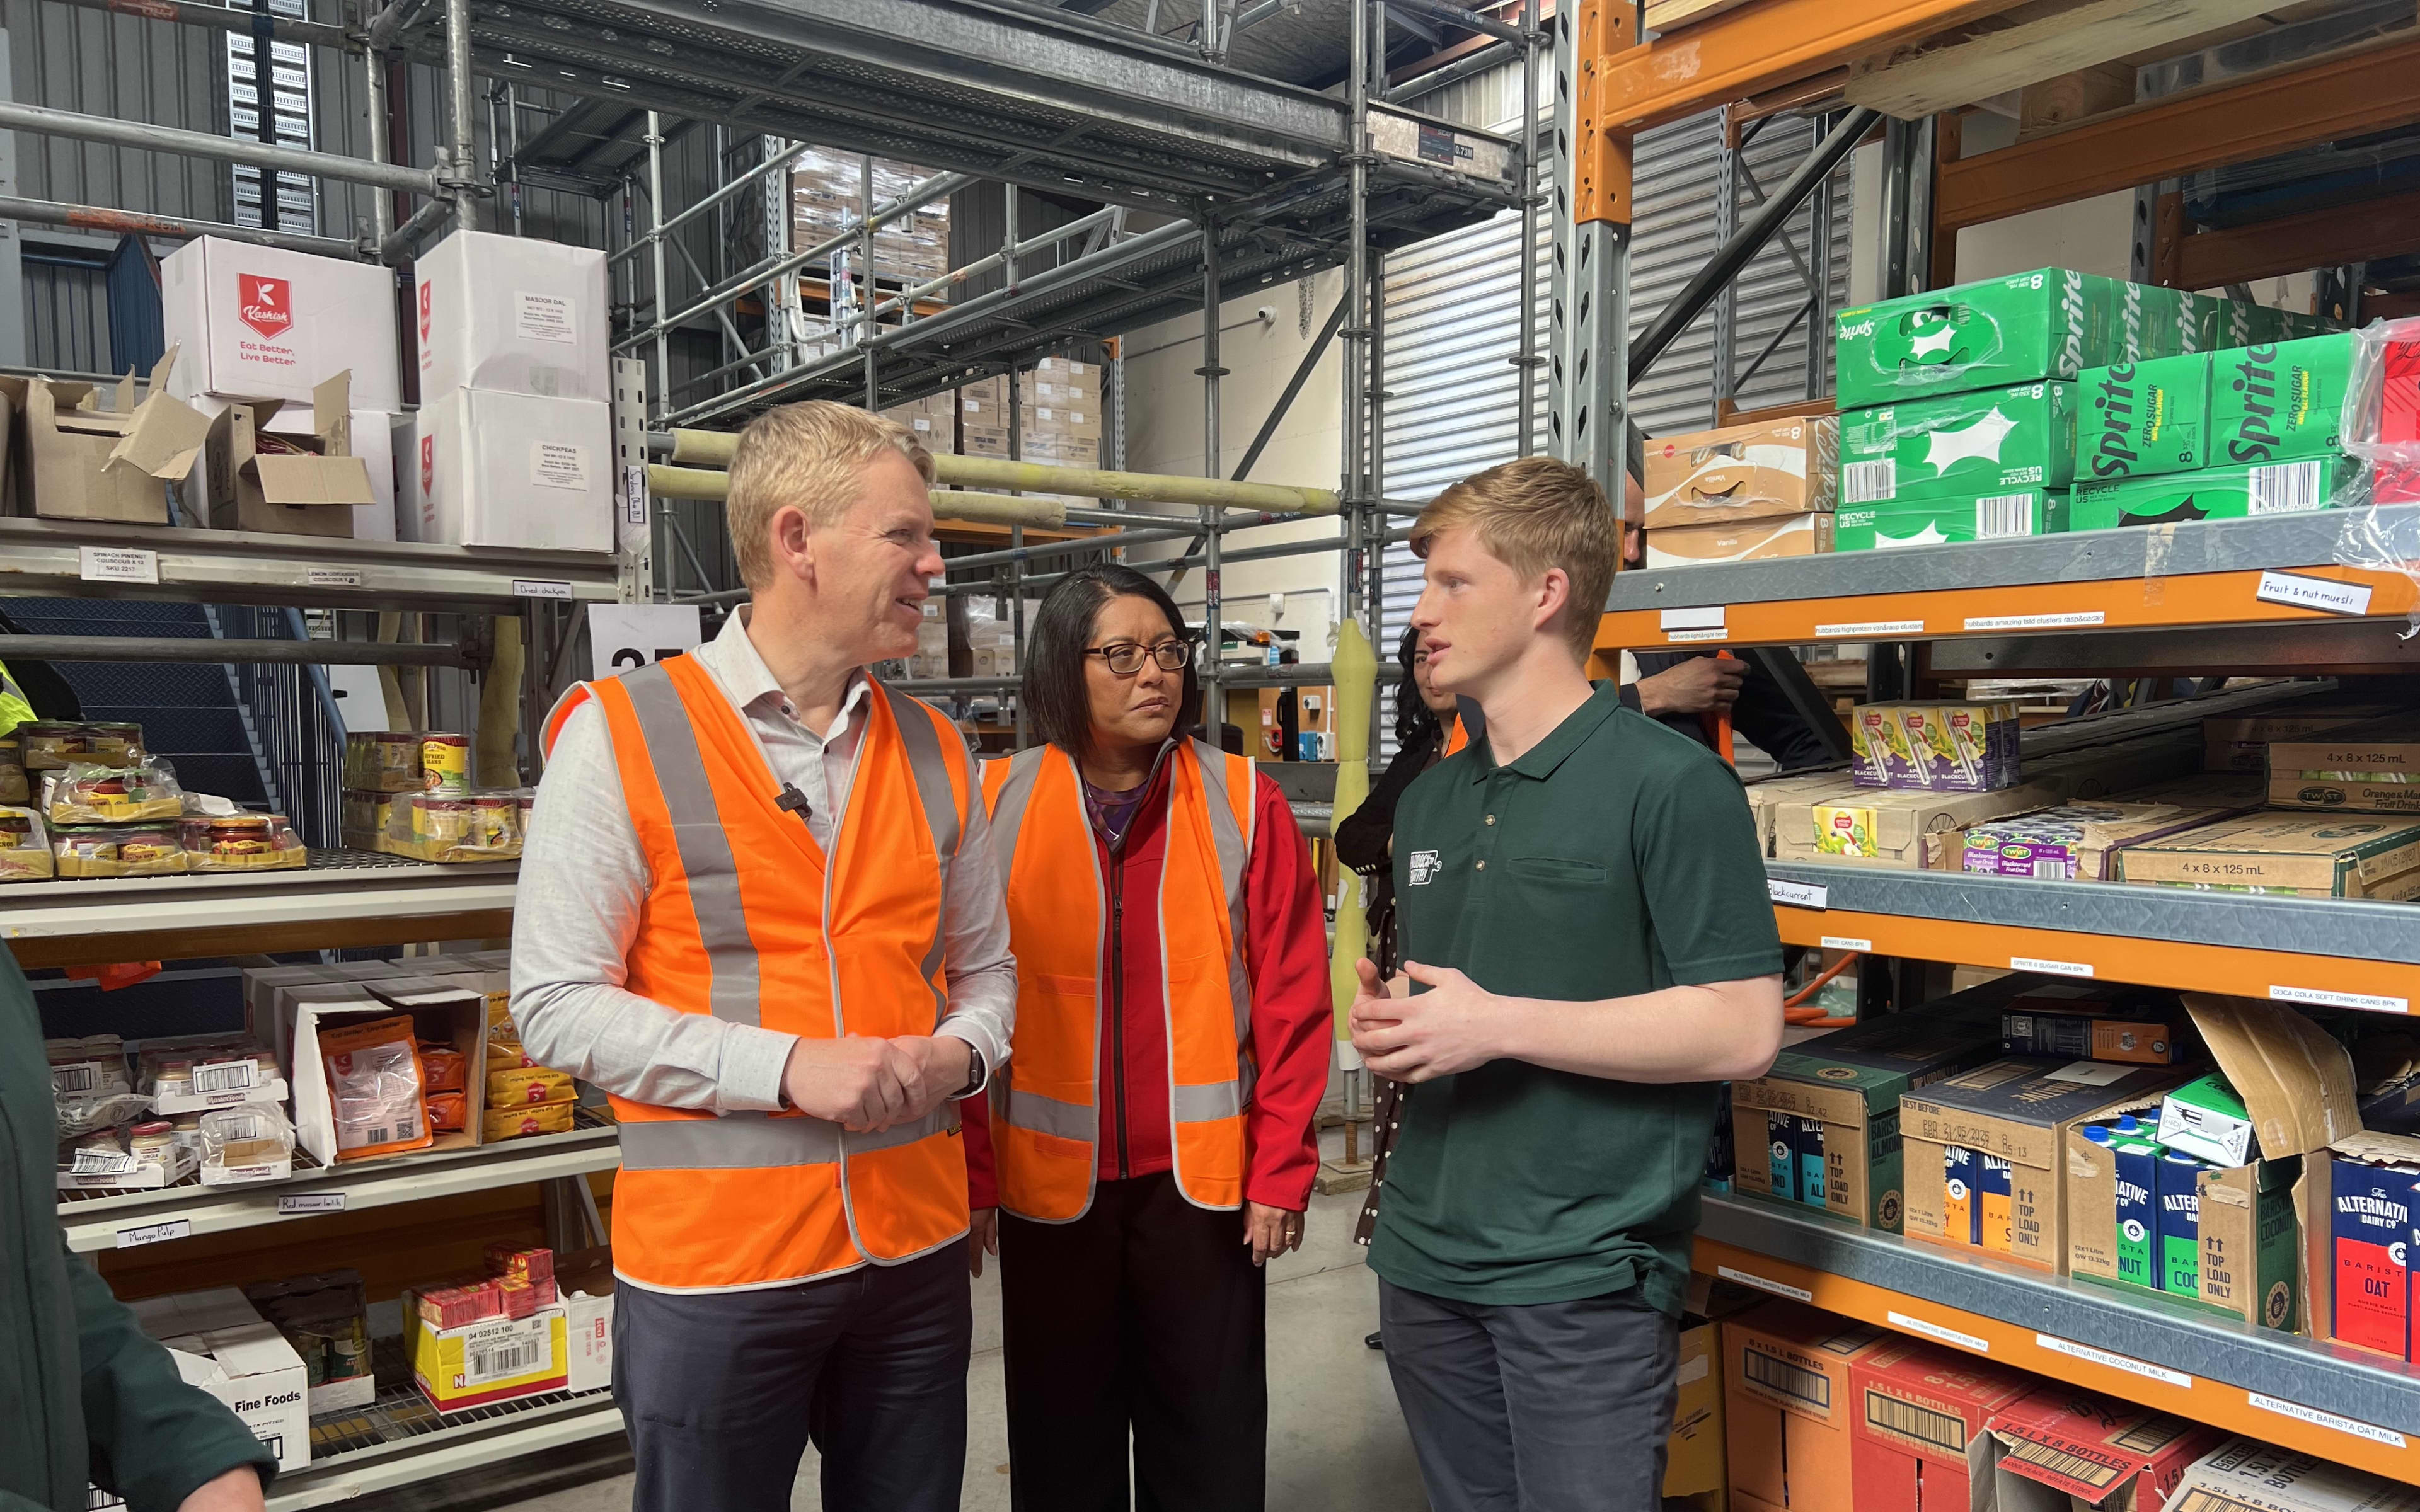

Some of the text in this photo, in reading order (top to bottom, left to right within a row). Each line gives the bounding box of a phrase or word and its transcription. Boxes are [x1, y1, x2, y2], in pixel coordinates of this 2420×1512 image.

[2031, 273, 2044, 290] 8
[243, 305, 289, 324] Kashish
[1839, 319, 1875, 340] Sprite
[2058, 269, 2083, 379] Sprite
[240, 341, 295, 356] Eat Better,
[241, 352, 296, 365] Live Better
[2031, 384, 2044, 399] 8
[2302, 370, 2310, 398] FLAVOUR
[2228, 342, 2280, 462] Sprite
[2285, 365, 2302, 432] ZERO SUGAR
[2091, 362, 2138, 476] Sprite
[2142, 384, 2157, 448] ZERO SUGAR
[1790, 426, 1801, 440] 8
[542, 445, 577, 454] CHICKPEAS
[2179, 450, 2193, 463] 8
[2028, 465, 2043, 476] US
[1705, 474, 1726, 483] Vanilla
[1999, 473, 2043, 486] RECYCLE
[2076, 484, 2120, 496] RECYCLE
[2076, 495, 2089, 504] US
[1820, 517, 1829, 529] 8
[1839, 511, 1876, 520] RECYCLE
[1839, 520, 1851, 529] US
[1716, 539, 1738, 547] Vanilla
[2264, 581, 2353, 607] Fruit & nut muesli
[1841, 625, 1872, 634] highprotein
[1873, 624, 1899, 632] van&rasp
[1995, 619, 2022, 629] amazing
[2036, 617, 2061, 625] clusters
[2063, 615, 2104, 624] rasp&cacao
[2326, 753, 2333, 762] 4
[2346, 753, 2353, 762] 8
[2366, 754, 2385, 762] 125
[2388, 755, 2406, 764] mL
[2362, 788, 2397, 800] Orange
[2375, 799, 2397, 809] Fruit
[2002, 860, 2031, 868] Blackcurrant
[2182, 864, 2189, 873] 4
[2203, 864, 2210, 873] 8
[2223, 864, 2244, 874] 125
[2245, 866, 2265, 876] mL
[2273, 988, 2293, 996] COCA
[2336, 995, 2358, 1004] DRINK
[2360, 998, 2380, 1006] CANS
[1903, 1099, 1940, 1116] BEST BEFORE
[1829, 1166, 1844, 1179] TOP
[1830, 1179, 1848, 1193] LOAD
[2371, 1187, 2387, 1199] The
[282, 1196, 296, 1209] Red
[1831, 1192, 1848, 1205] ONLY
[2018, 1204, 2035, 1218] TOP
[2018, 1218, 2040, 1234] LOAD
[2361, 1214, 2385, 1227] DAIRY
[129, 1225, 175, 1243] Mango Pulp
[2018, 1232, 2039, 1247] ONLY
[2206, 1253, 2225, 1268] TOP
[2206, 1268, 2231, 1285] LOAD
[2207, 1283, 2231, 1299] ONLY
[2365, 1278, 2390, 1298] OAT
[501, 1325, 514, 1334] 100
[1906, 1319, 1987, 1348] ALTERNATIVE BARISTA SOY MILK
[1786, 1351, 1824, 1372] BOTTLES
[2058, 1342, 2168, 1380] ALTERNATIVE COCONUT MILK
[235, 1391, 301, 1413] Fine Foods
[1869, 1380, 1884, 1390] 1.5
[1896, 1388, 1903, 1397] X
[1905, 1391, 1913, 1400] 8
[1915, 1392, 1962, 1416] BOTTLES
[2254, 1396, 2402, 1444] ALTERNATIVE BARISTA OAT MILK
[2004, 1423, 2025, 1436] 1.5
[2038, 1434, 2048, 1443] X
[2051, 1439, 2065, 1448] 8
[2069, 1444, 2132, 1470] BOTTLES
[2199, 1482, 2229, 1495] 1.5L
[2237, 1493, 2249, 1502] X
